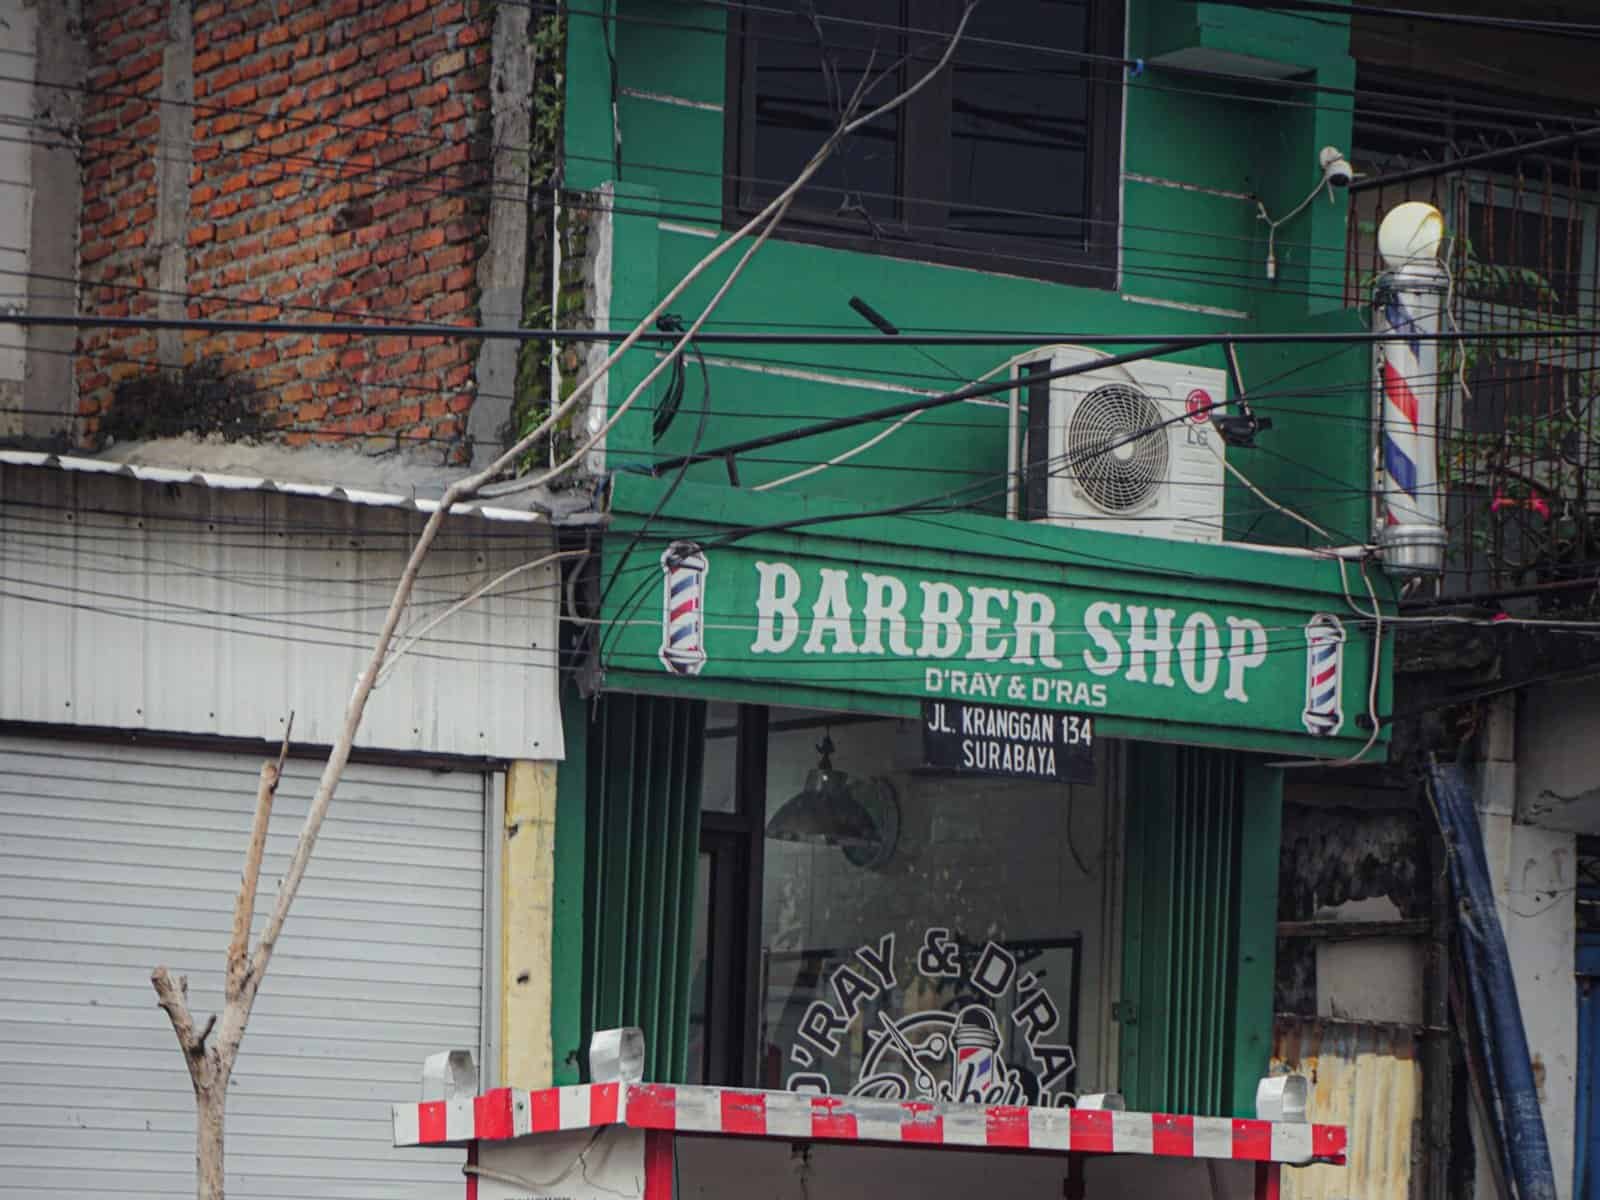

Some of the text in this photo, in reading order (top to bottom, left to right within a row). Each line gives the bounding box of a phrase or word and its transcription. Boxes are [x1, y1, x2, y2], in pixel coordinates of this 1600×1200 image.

[1186, 425, 1208, 446] LG
[750, 560, 1268, 704] BARBER SHOP
[925, 667, 1107, 707] D'RAY & D'RAS
[928, 703, 1092, 746] JL. KRANGGAN 134
[962, 739, 1056, 777] SURABAYA
[919, 928, 961, 977] &
